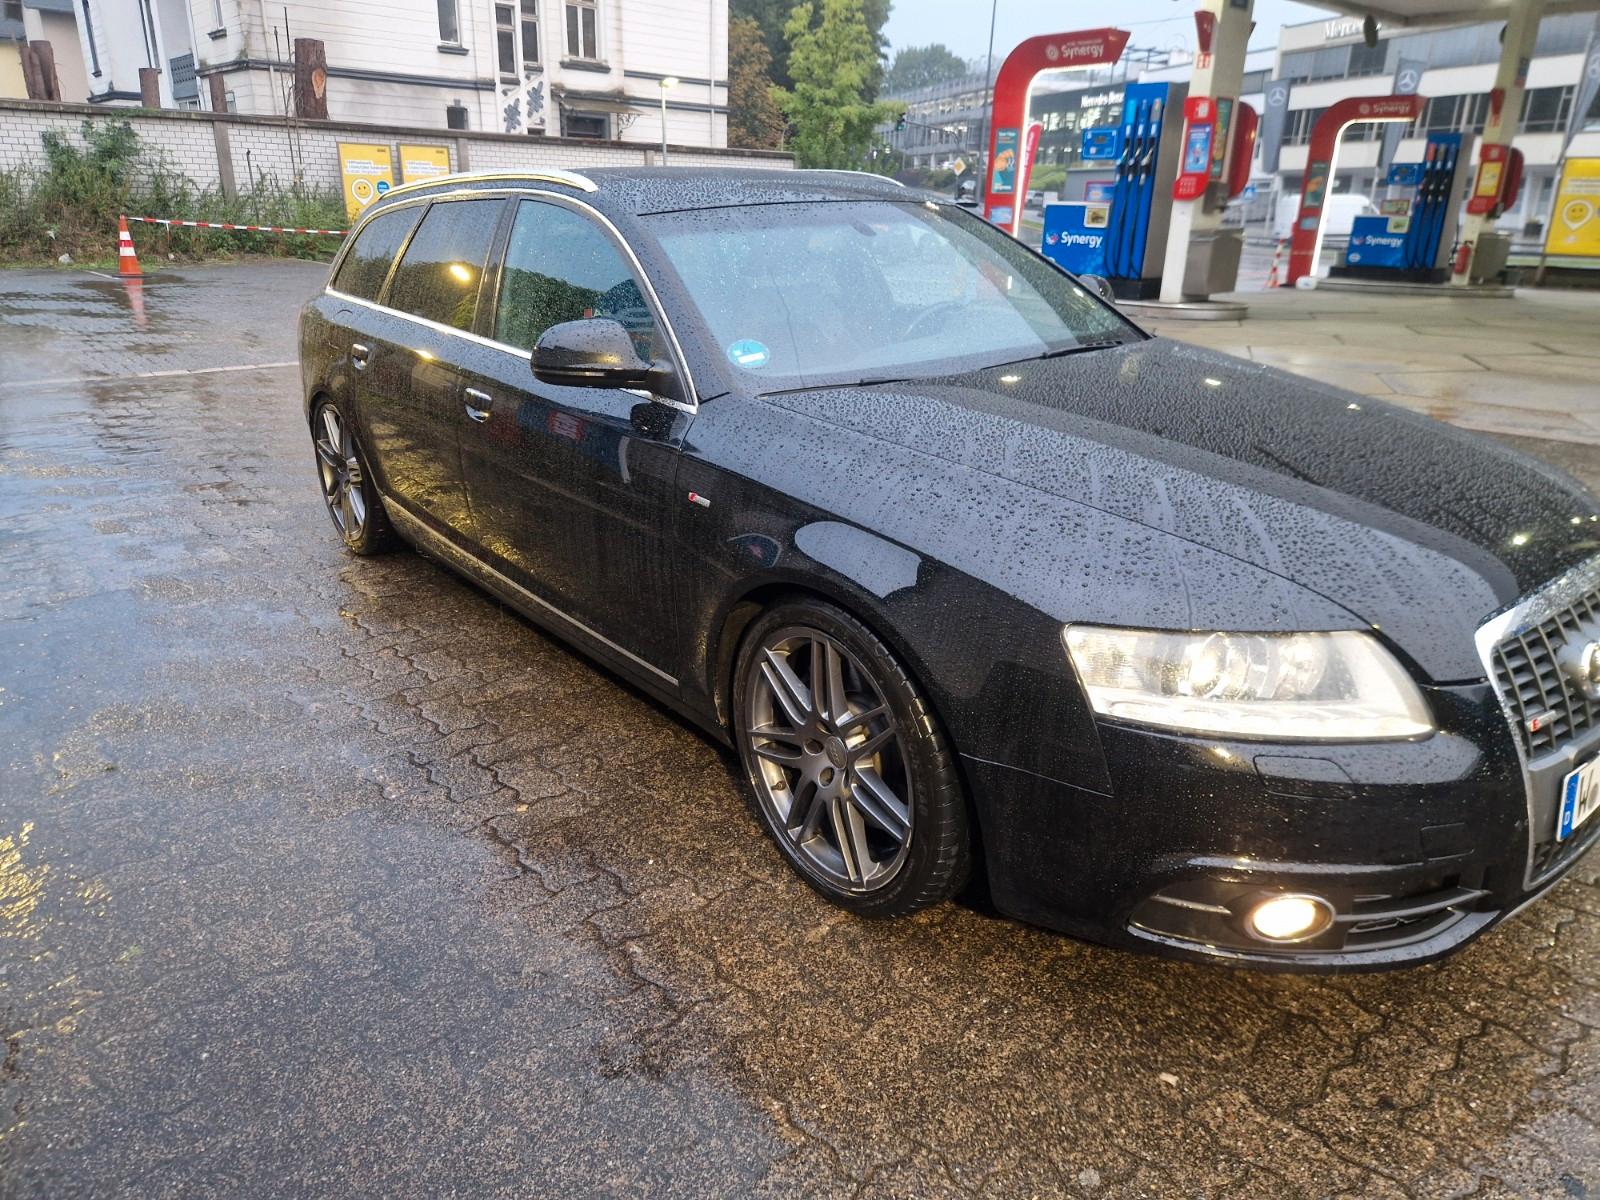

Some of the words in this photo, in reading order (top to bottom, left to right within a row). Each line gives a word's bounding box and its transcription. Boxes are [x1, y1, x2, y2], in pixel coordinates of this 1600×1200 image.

[1061, 44, 1104, 60] Synergy
[1061, 231, 1103, 249] Synergy
[1365, 234, 1404, 249] Synergy
